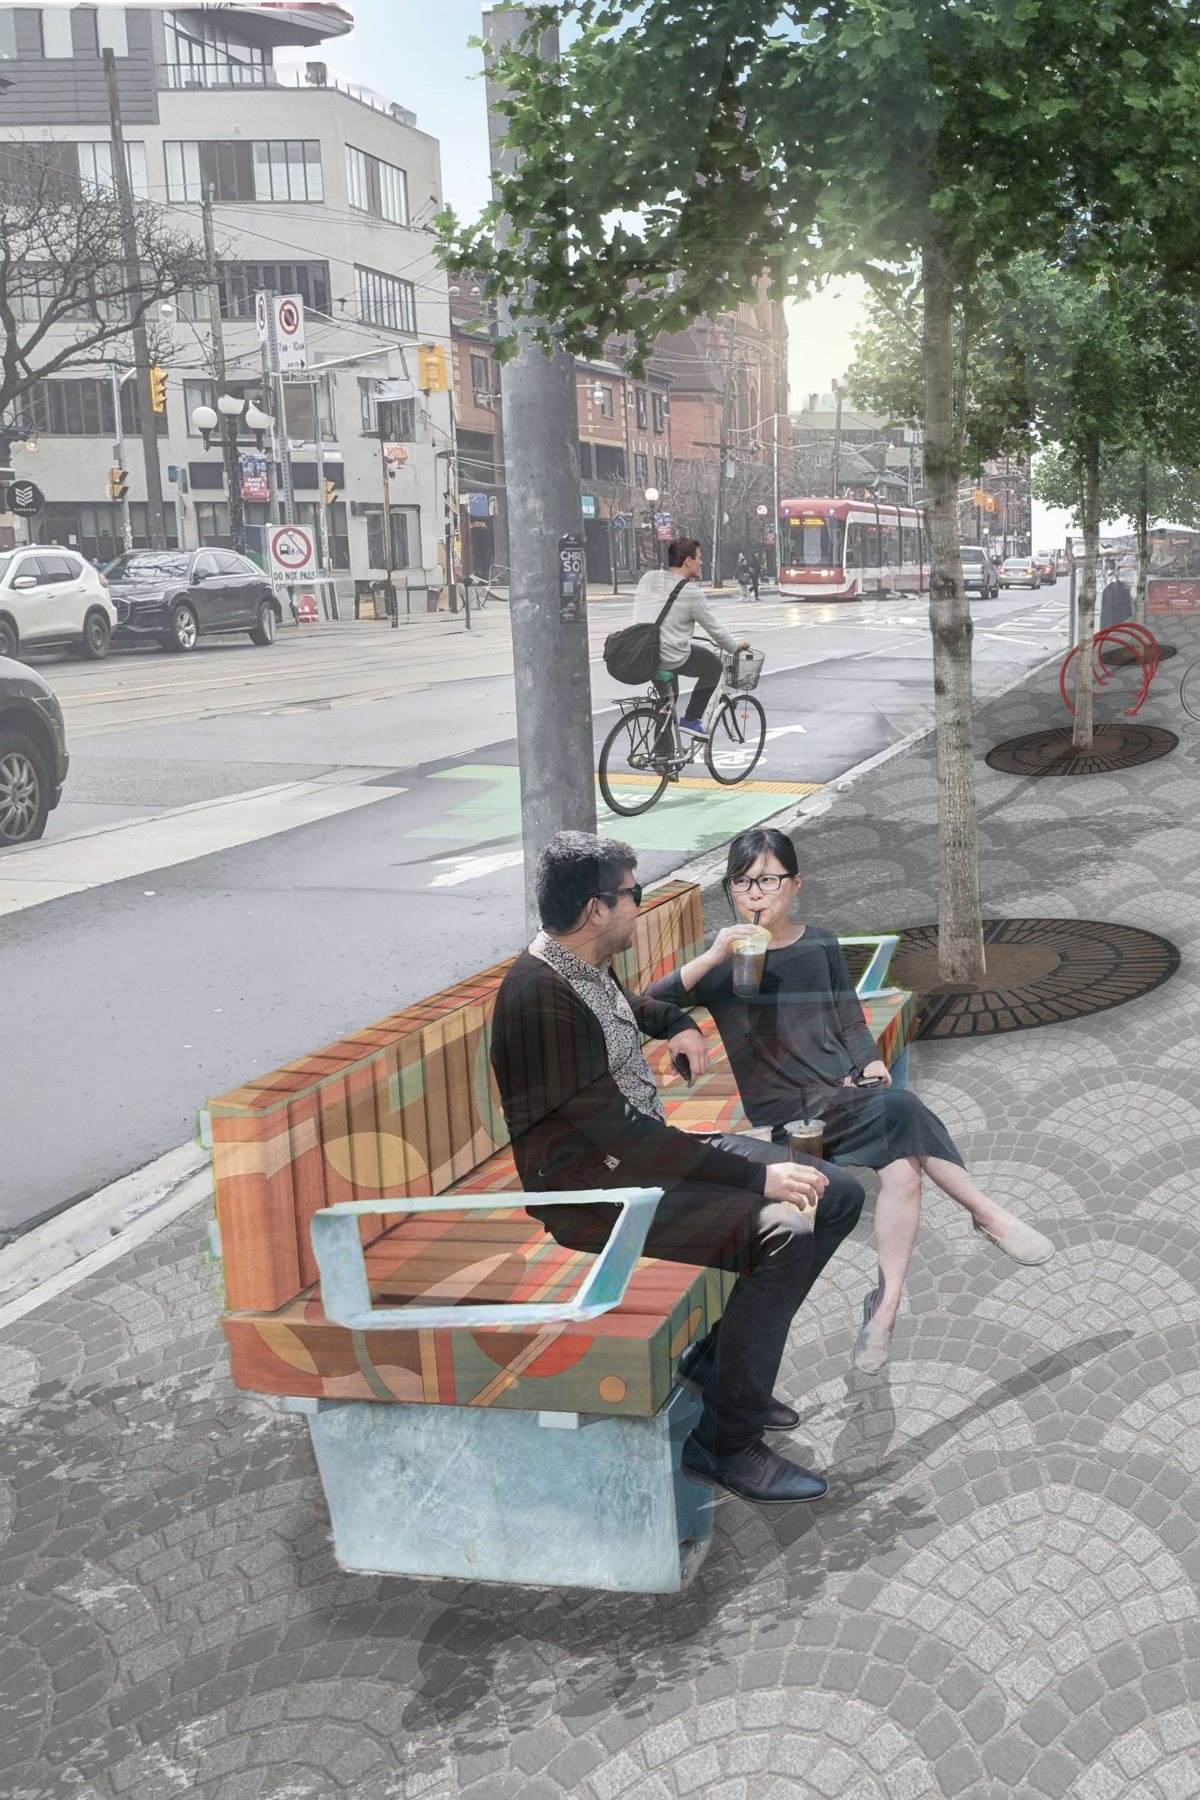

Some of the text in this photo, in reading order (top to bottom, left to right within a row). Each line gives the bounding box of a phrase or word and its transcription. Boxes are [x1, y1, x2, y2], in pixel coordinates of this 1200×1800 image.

[273, 571, 315, 580] DO NOT PASS
